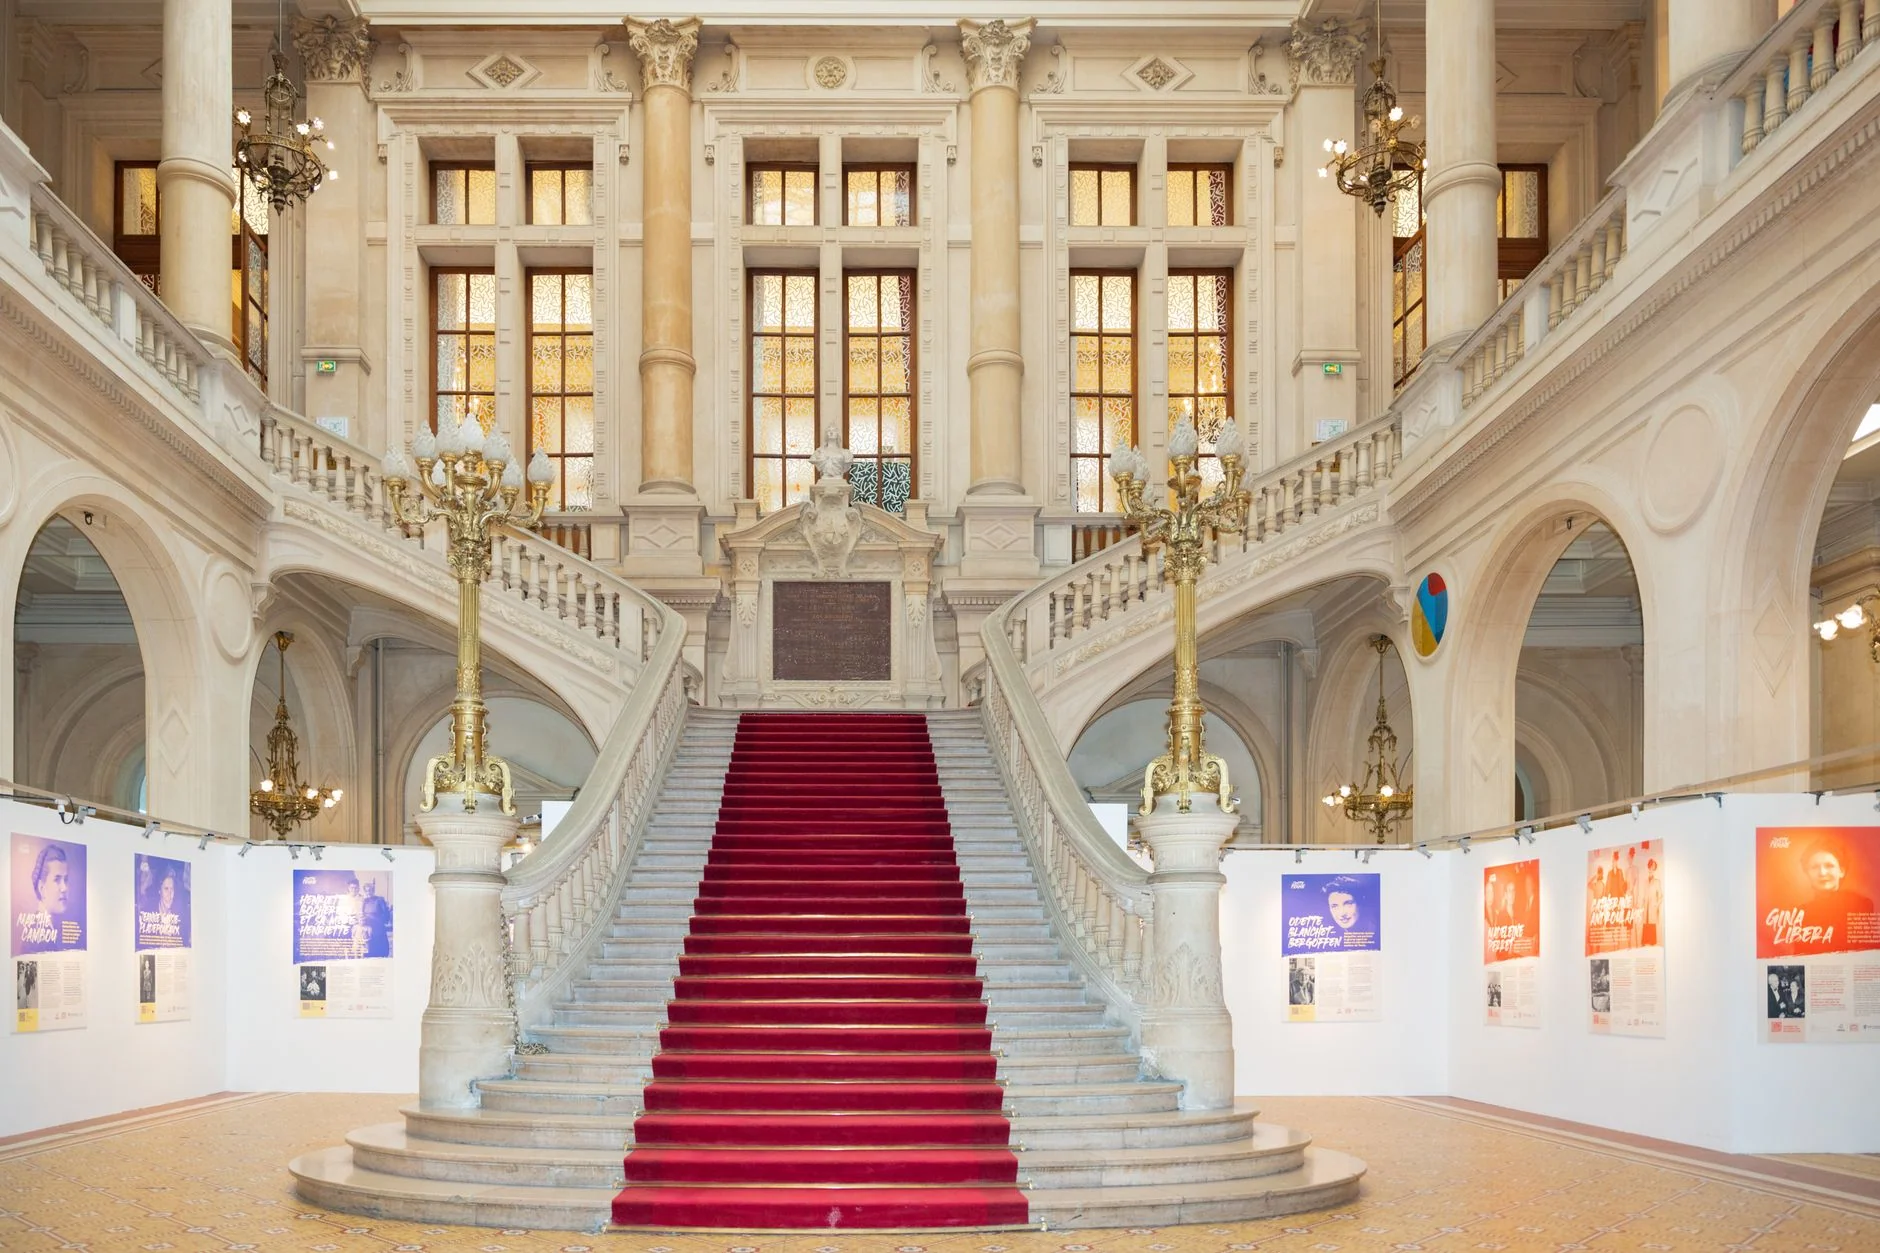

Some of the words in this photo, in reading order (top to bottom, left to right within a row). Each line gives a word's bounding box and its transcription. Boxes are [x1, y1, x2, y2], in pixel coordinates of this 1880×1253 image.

[1288, 915, 1323, 927] ODETTE
[1765, 907, 1805, 931] GINA
[299, 924, 351, 937] HENRIETTE
[1288, 924, 1336, 938] BLANCHET-
[1773, 925, 1834, 944] LIBERA
[1288, 936, 1342, 949] BERGOFFEN
